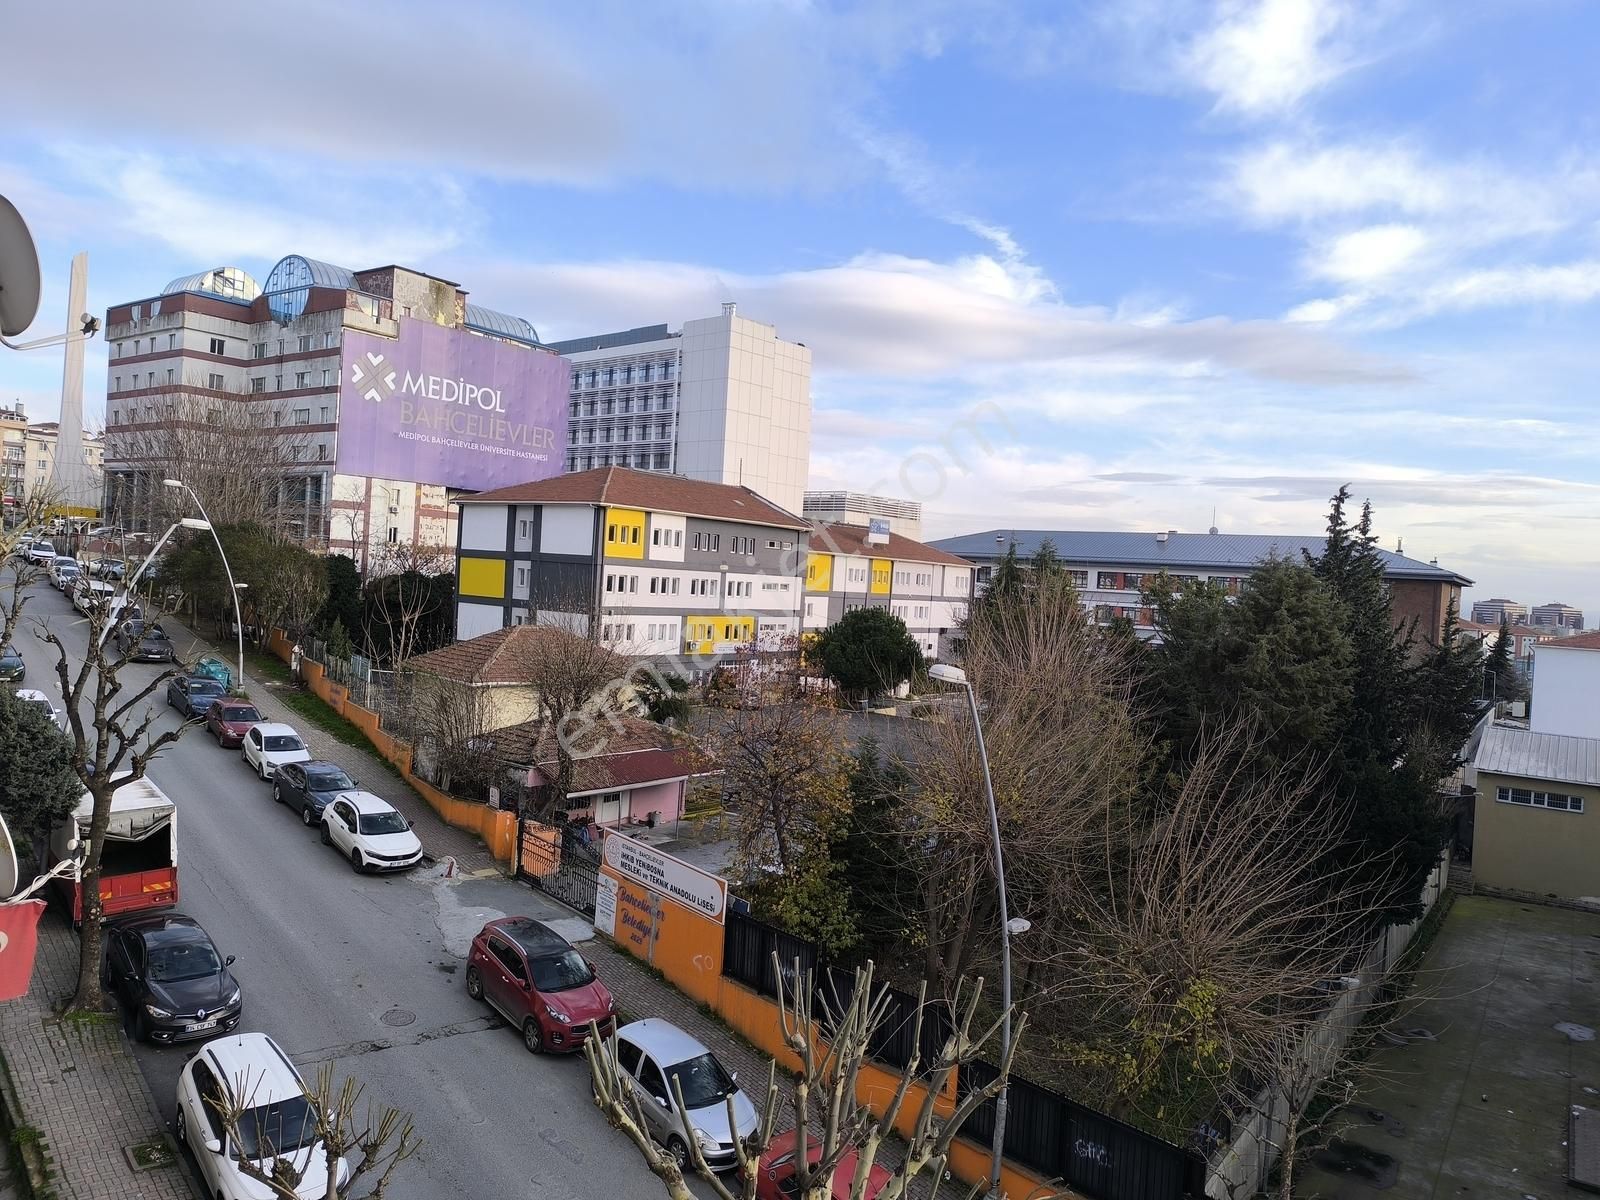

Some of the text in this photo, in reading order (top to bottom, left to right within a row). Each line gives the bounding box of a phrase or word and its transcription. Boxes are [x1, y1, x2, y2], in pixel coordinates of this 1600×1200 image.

[401, 369, 506, 413] MEDİPOL
[398, 431, 430, 443] MEDİPOL
[669, 884, 697, 903] ANADOLU
